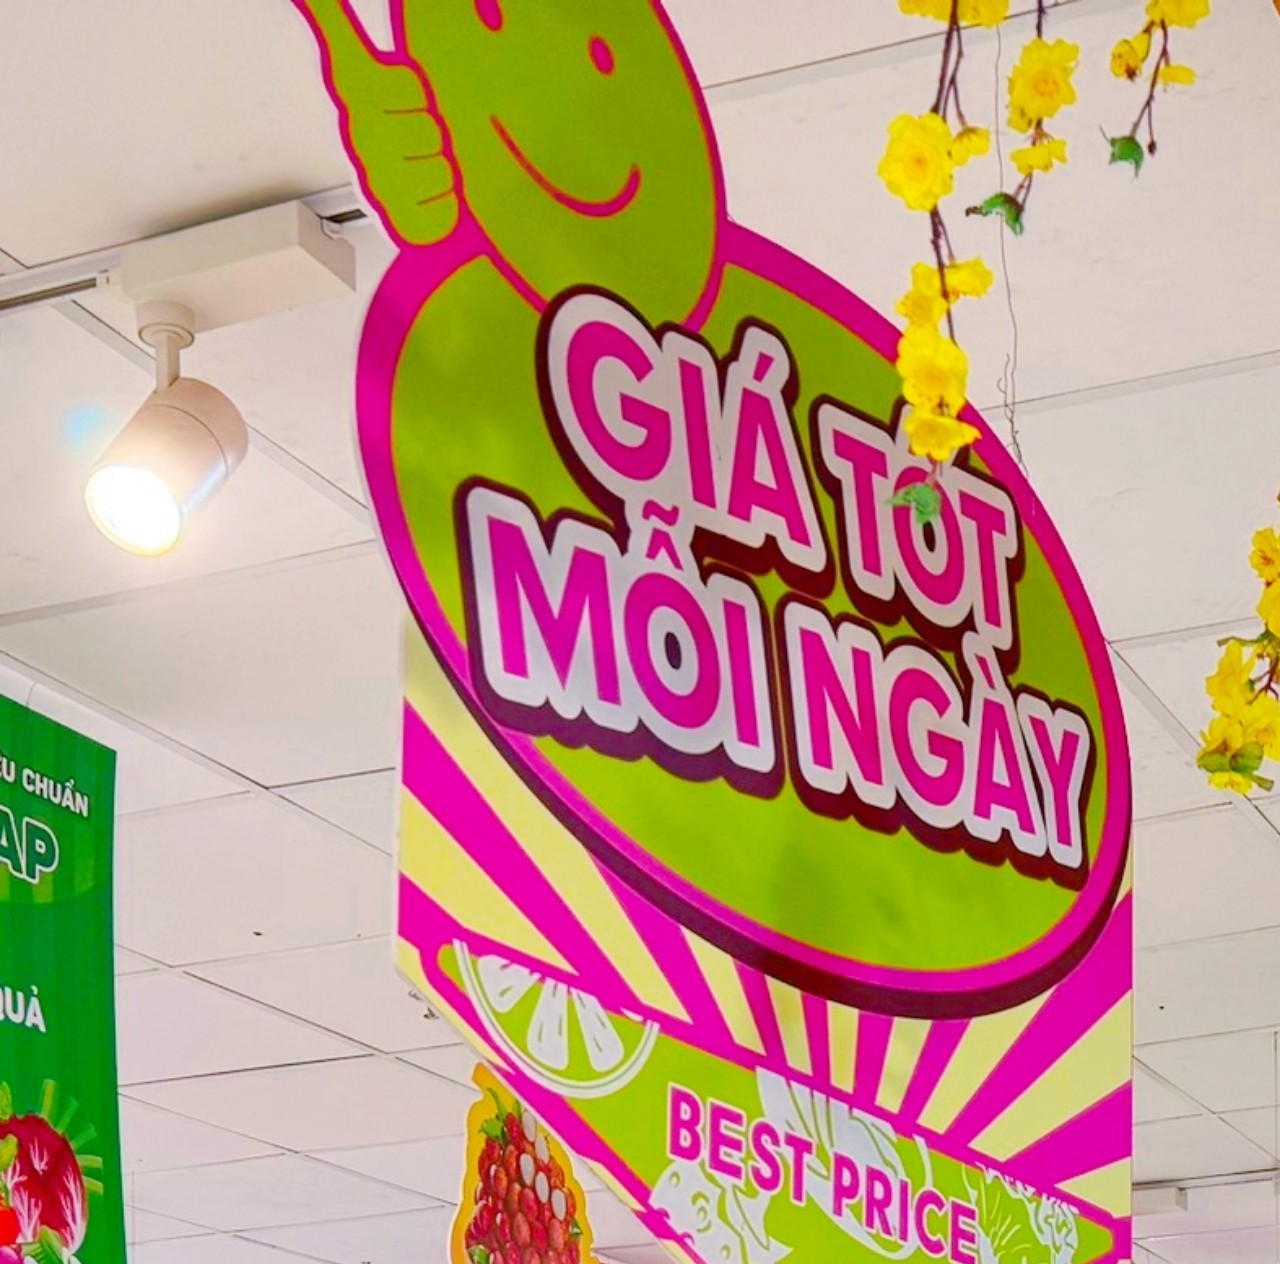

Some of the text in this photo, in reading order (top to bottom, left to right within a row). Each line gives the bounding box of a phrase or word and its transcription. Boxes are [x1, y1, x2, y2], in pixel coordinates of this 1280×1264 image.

[567, 320, 812, 547] GIÁ
[486, 500, 1079, 846] MỖI NGÀY
[22, 767, 89, 818] CHUẨN
[668, 1083, 814, 1205] BEST
